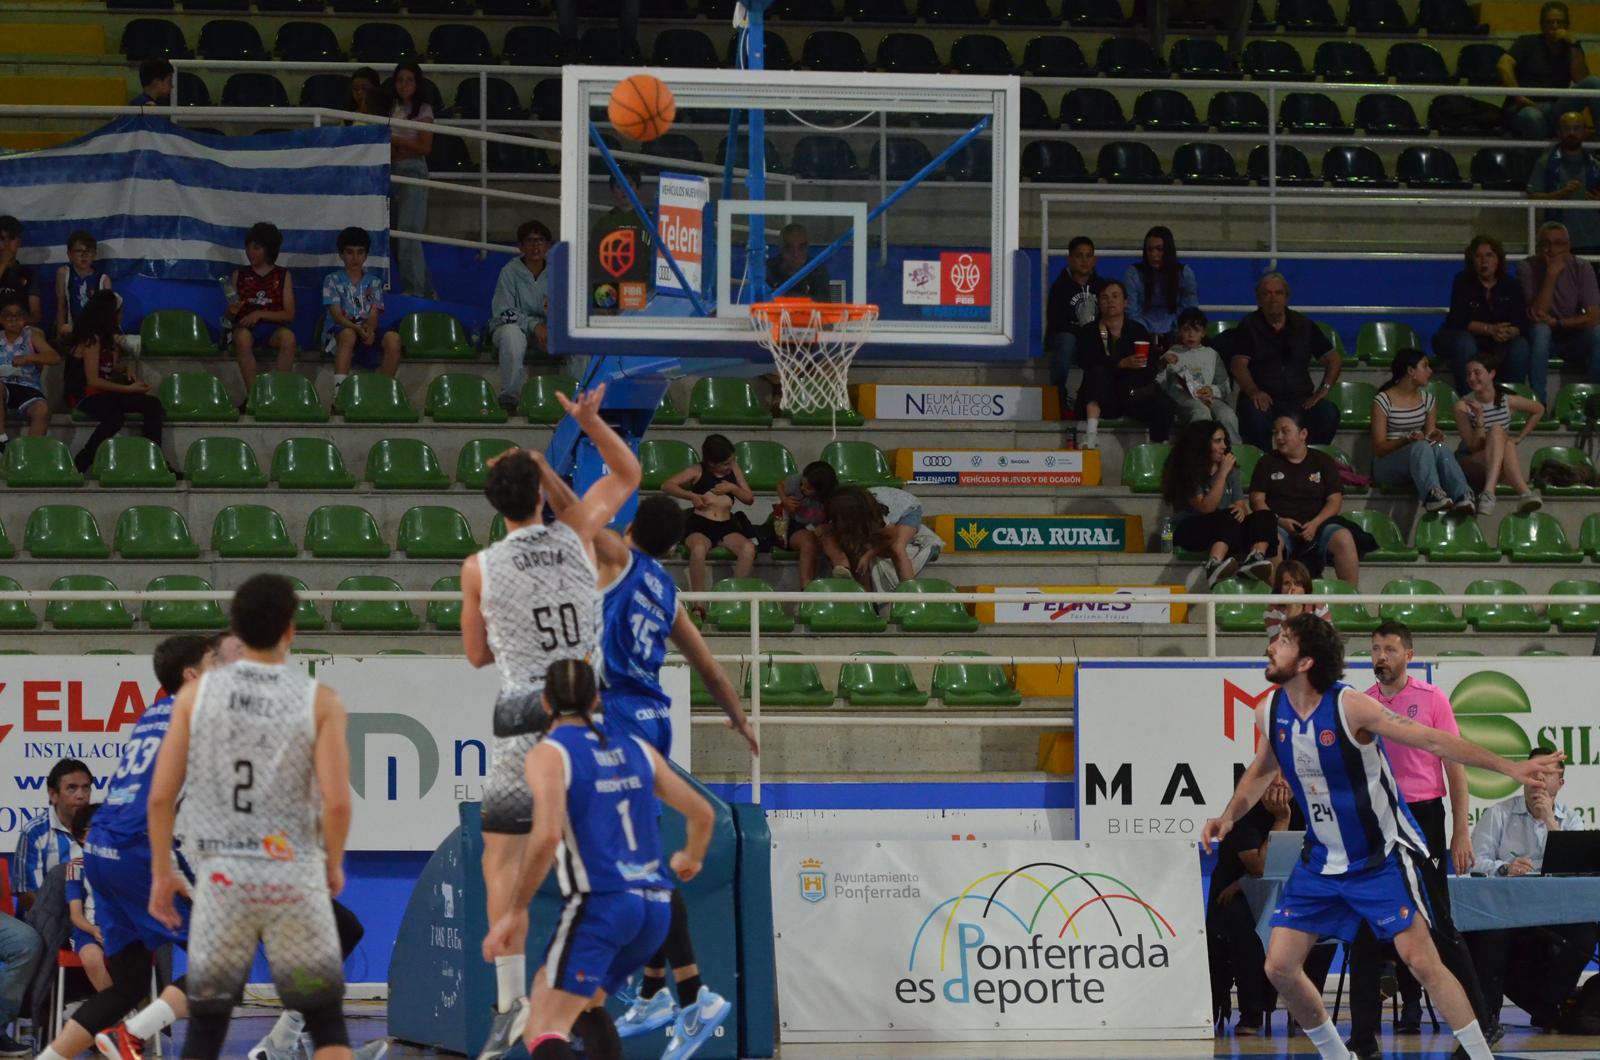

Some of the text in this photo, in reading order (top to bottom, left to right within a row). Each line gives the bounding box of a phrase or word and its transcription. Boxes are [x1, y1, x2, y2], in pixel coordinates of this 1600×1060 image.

[961, 474, 1000, 483] VEHÍCULOS
[1049, 474, 1081, 483] OCASIÓN
[992, 527, 1120, 546] CAJA RURAL
[533, 602, 581, 652] 50
[630, 613, 660, 660] 15
[23, 681, 168, 732] ELA
[117, 736, 161, 779] 33
[233, 760, 253, 813] 2
[616, 799, 638, 851] 1
[1108, 818, 1194, 834] BIERZO
[1312, 803, 1333, 822] 24
[834, 872, 919, 885] Ayuntamiento
[834, 885, 921, 903] Ponferrada
[958, 923, 1169, 969] Ponferrada
[895, 972, 1105, 1013] es deporte
